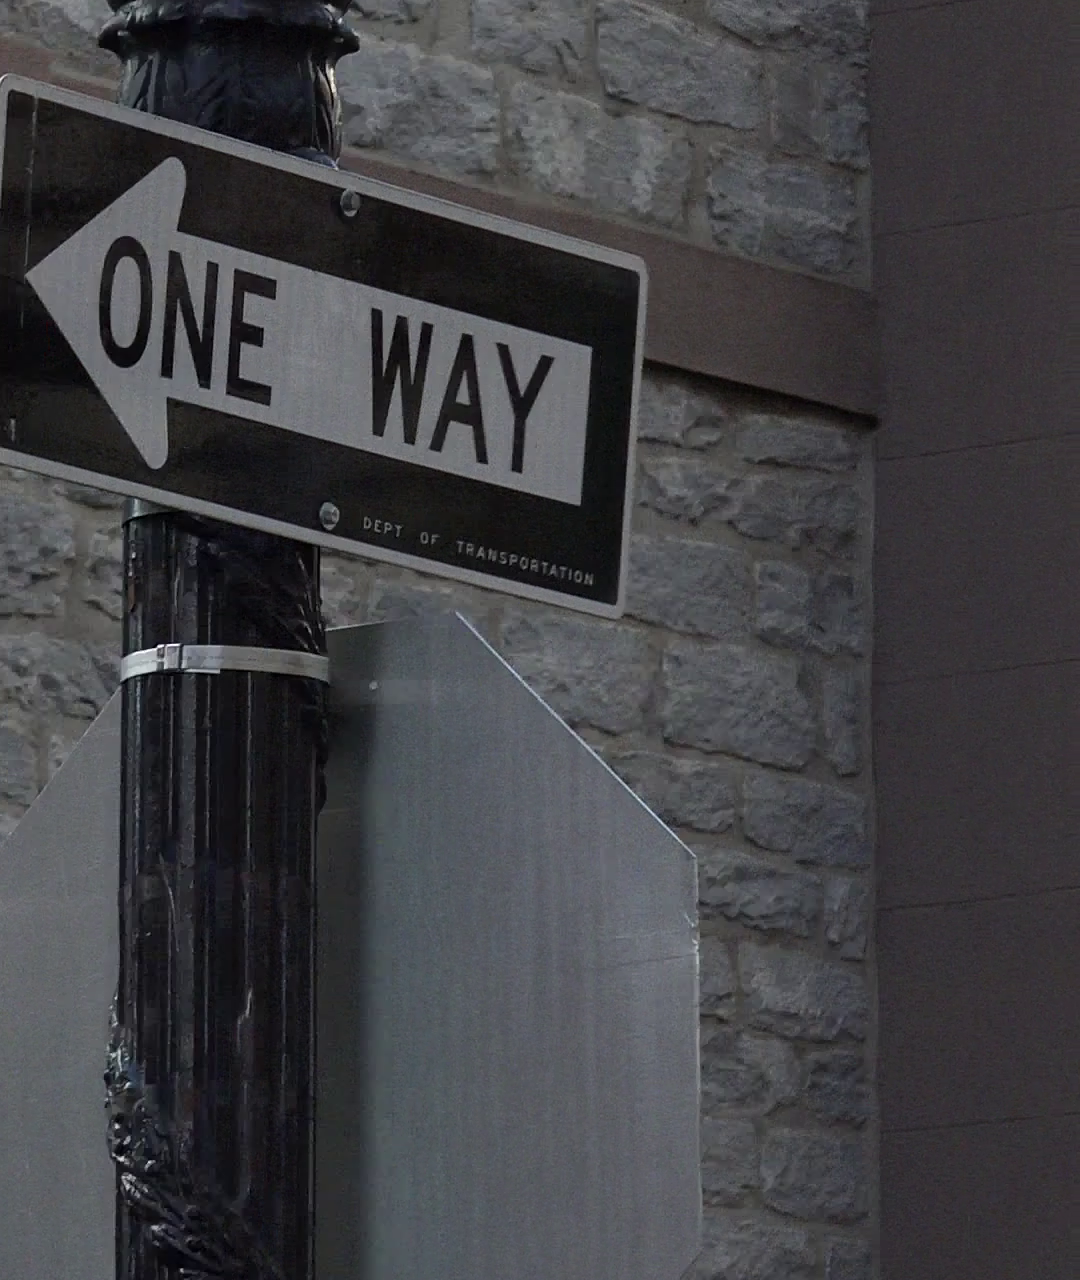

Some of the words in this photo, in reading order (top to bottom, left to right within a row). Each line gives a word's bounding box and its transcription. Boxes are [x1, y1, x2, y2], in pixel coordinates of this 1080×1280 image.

[98, 235, 278, 407] ONE
[370, 307, 555, 475] WAY
[363, 516, 404, 538] DEPT
[419, 531, 441, 545] OF
[456, 540, 595, 587] TRANSPORTATION
